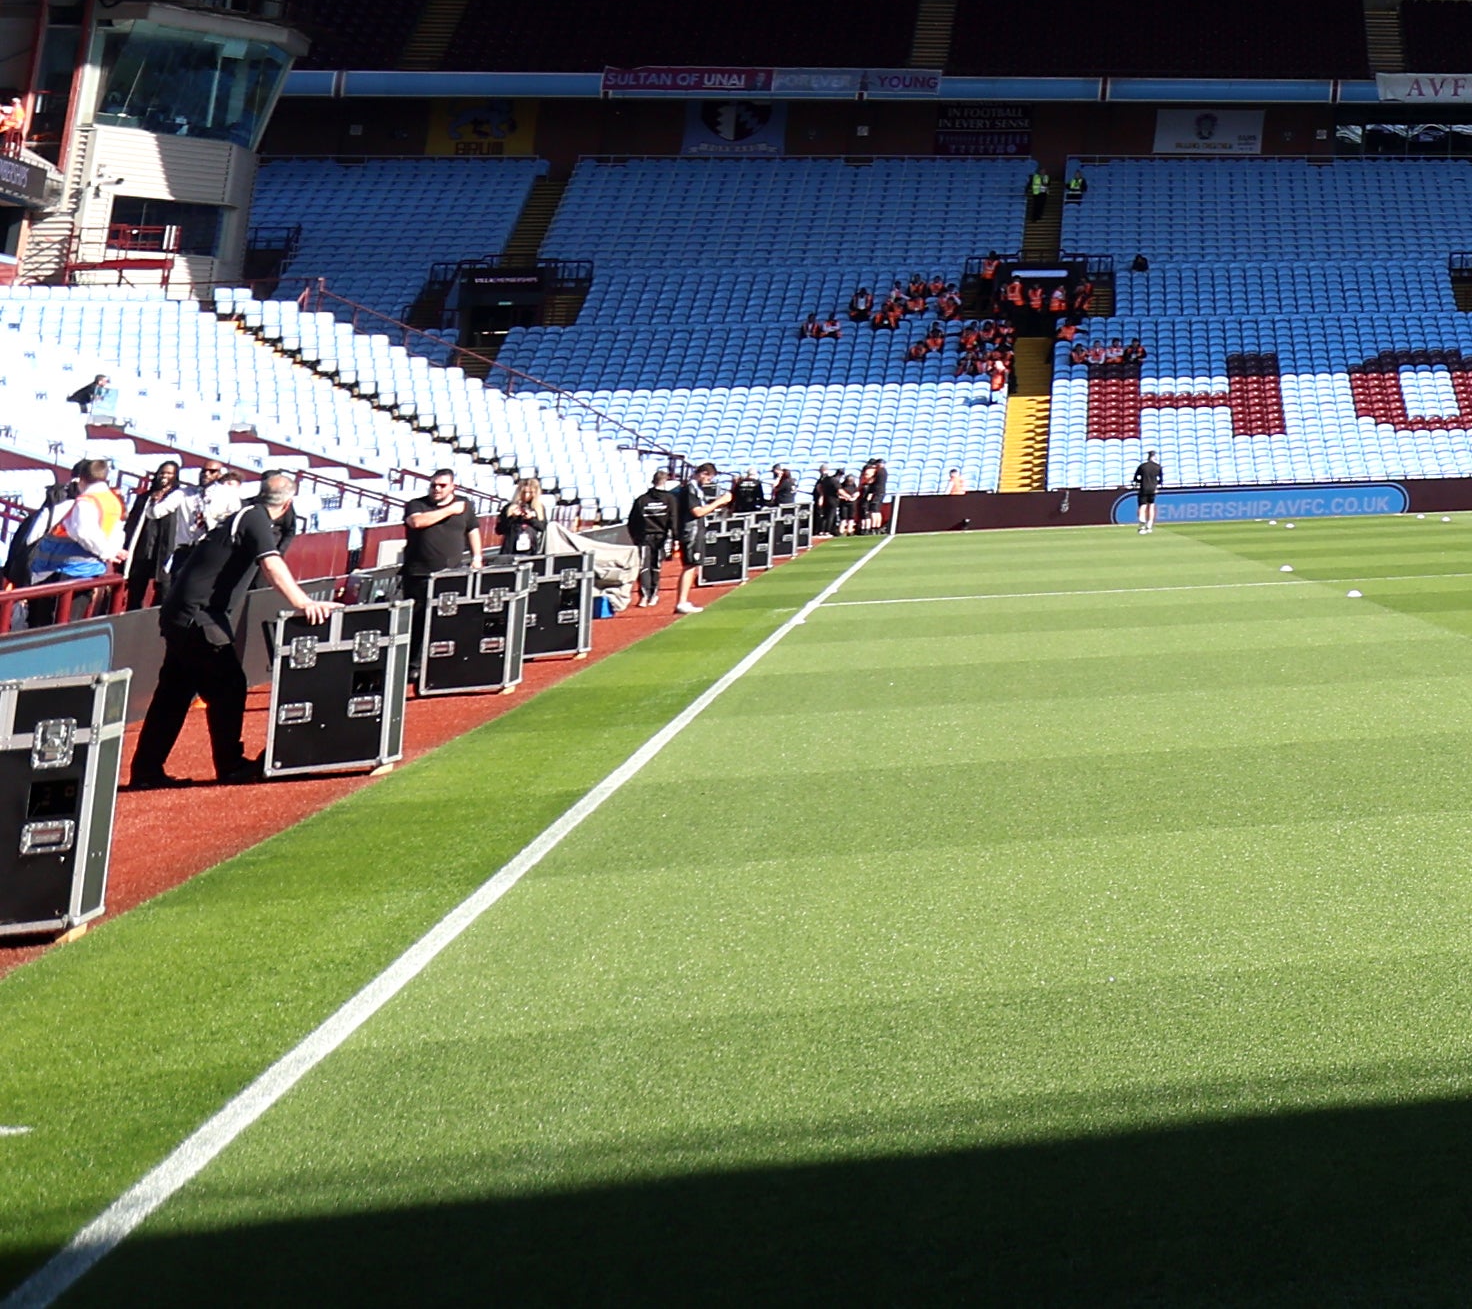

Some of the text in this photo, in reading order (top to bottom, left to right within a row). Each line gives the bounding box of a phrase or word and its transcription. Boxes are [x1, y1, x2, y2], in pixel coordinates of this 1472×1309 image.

[605, 72, 746, 87] SULTAN OF UNAI
[877, 75, 939, 89] YOUNG
[963, 107, 1024, 118] FOOTBALL
[938, 118, 1030, 128] IN EVERY SENSE
[1155, 495, 1390, 521] EMBERSHIP.AVFC.CO.UK
